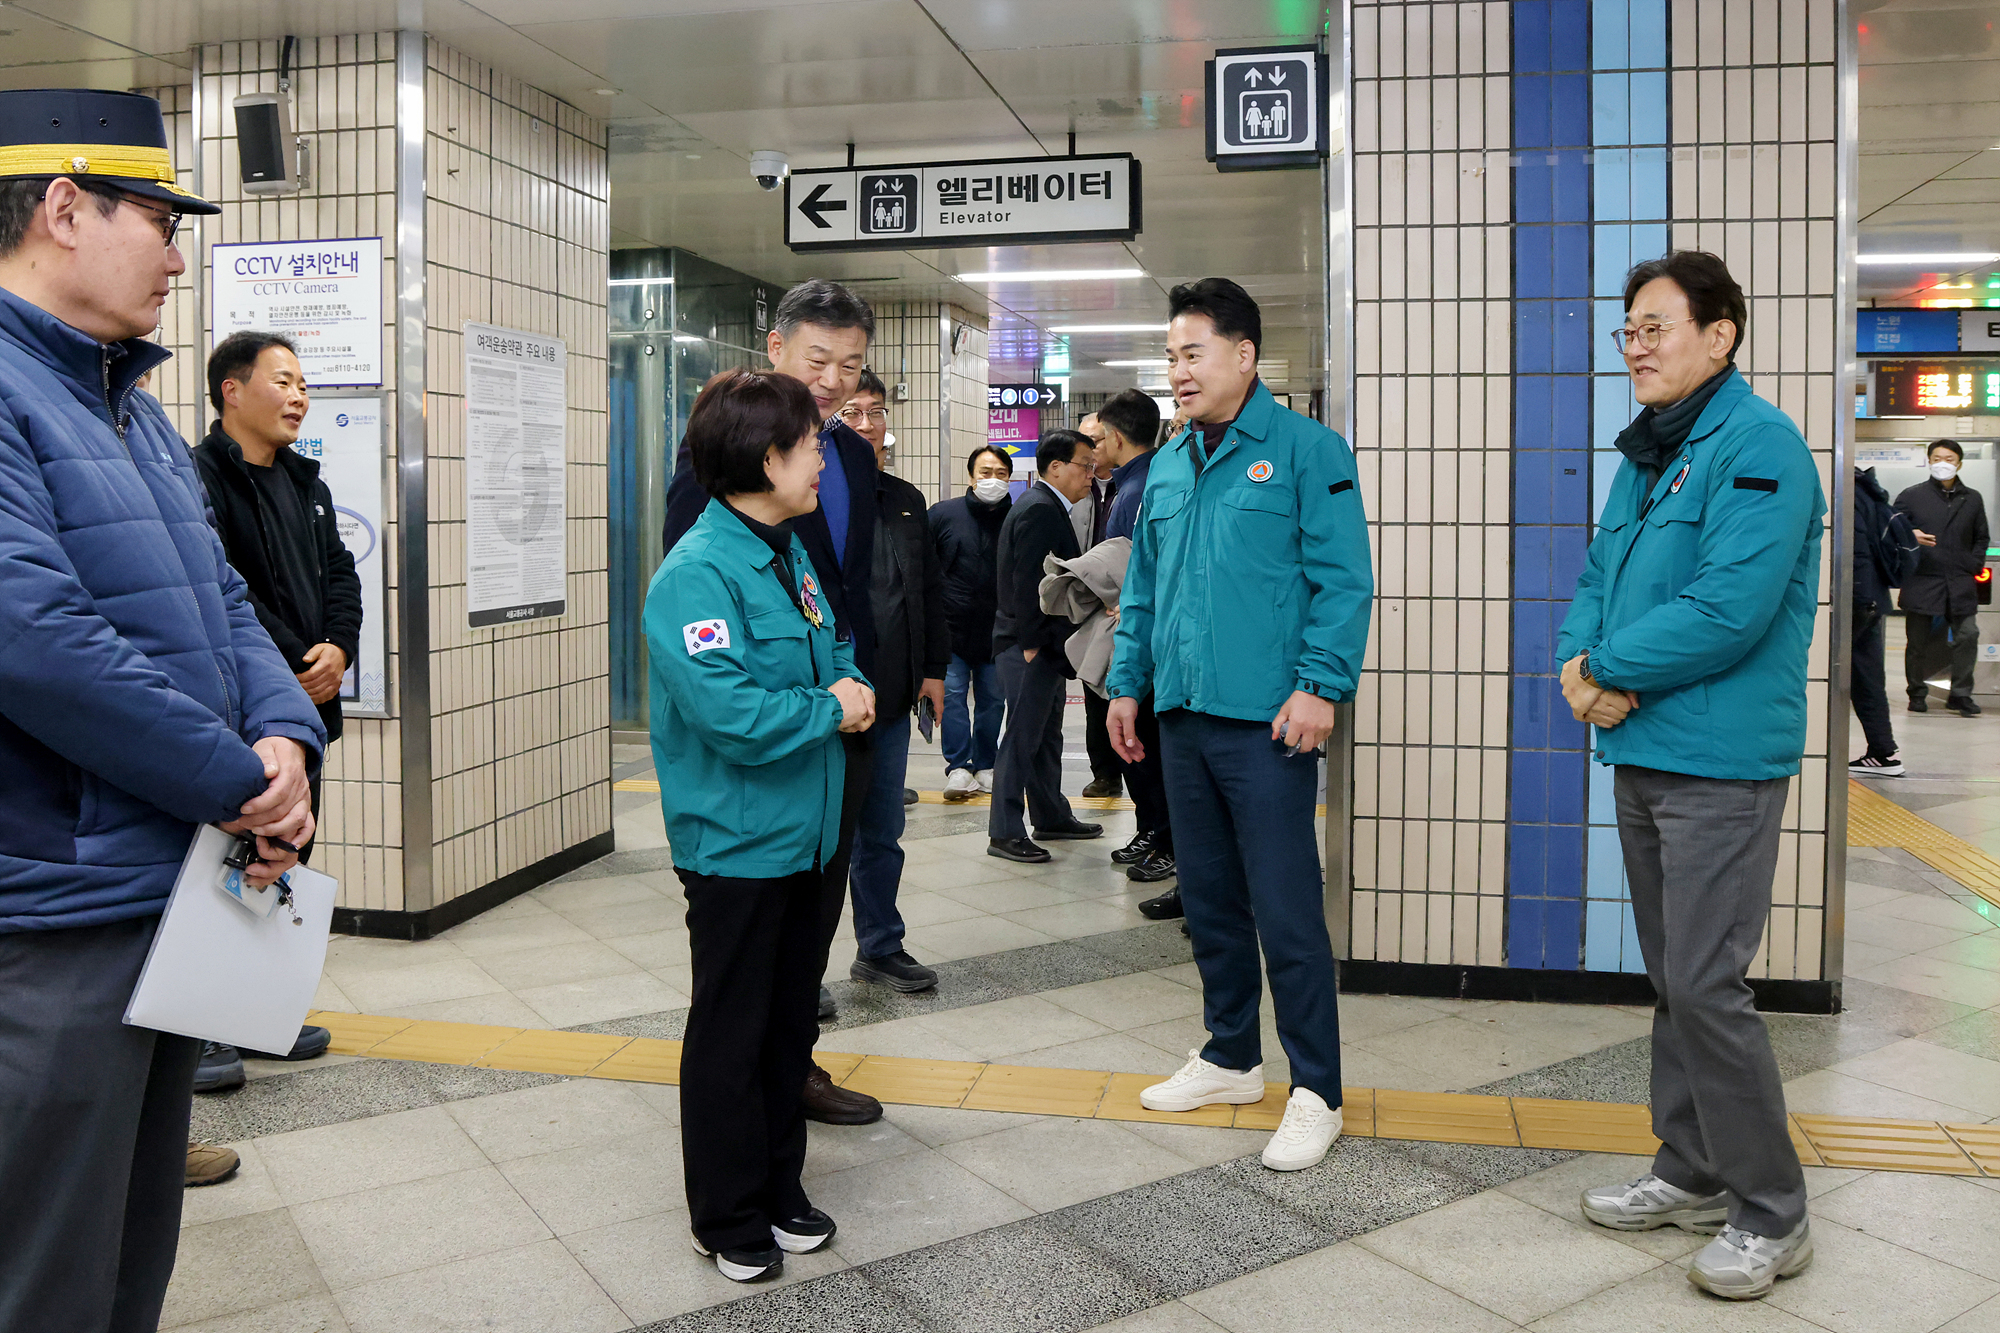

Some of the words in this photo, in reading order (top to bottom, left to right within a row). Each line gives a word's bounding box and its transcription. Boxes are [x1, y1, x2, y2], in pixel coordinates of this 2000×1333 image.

[936, 170, 1112, 207] 엘리베이터
[939, 210, 1012, 225] Elevator
[234, 255, 283, 276] CCTV
[287, 250, 359, 276] 설치안내
[253, 281, 291, 296] CCTV
[293, 281, 339, 295] Camera
[229, 311, 236, 319] 목
[248, 310, 255, 318] 적
[1877, 316, 1901, 326] 노원
[476, 333, 523, 357] 여객운송약관
[526, 342, 541, 358] 주요
[542, 345, 556, 362] 내용
[1889, 387, 1895, 395] 2
[989, 409, 1018, 424] 안내
[295, 438, 323, 457] 방법
